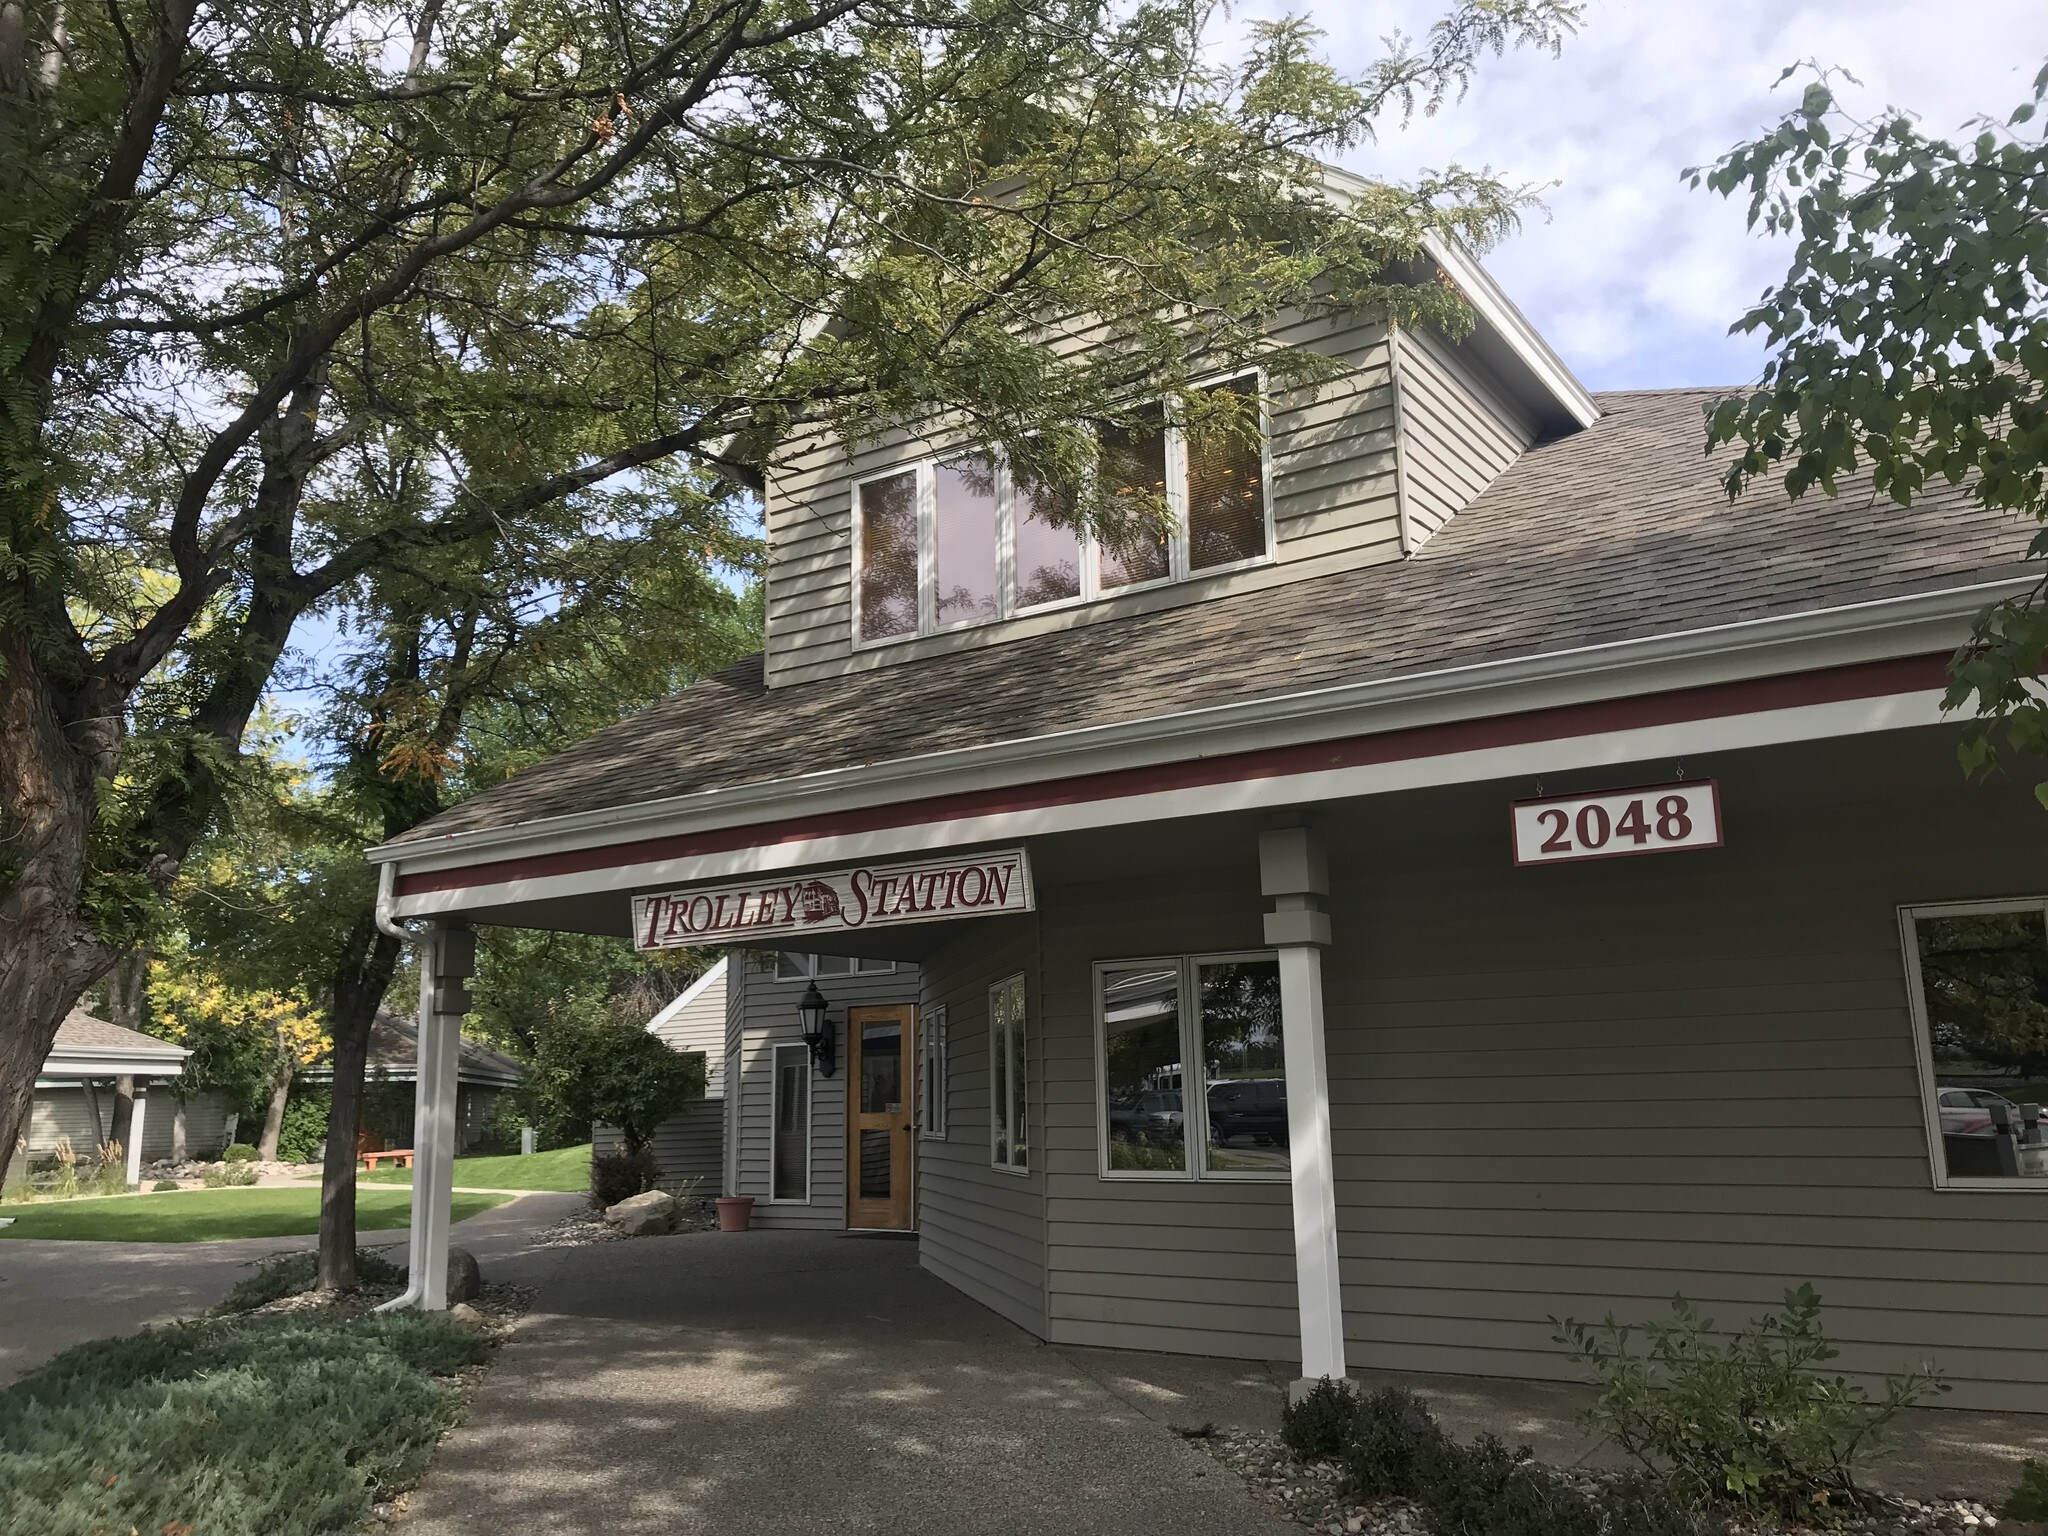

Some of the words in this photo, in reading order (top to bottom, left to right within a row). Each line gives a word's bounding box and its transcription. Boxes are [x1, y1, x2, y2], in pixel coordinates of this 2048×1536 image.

[1537, 795, 1693, 853] 2048
[643, 883, 802, 948] TROLLEY
[841, 865, 1016, 927] STATION
